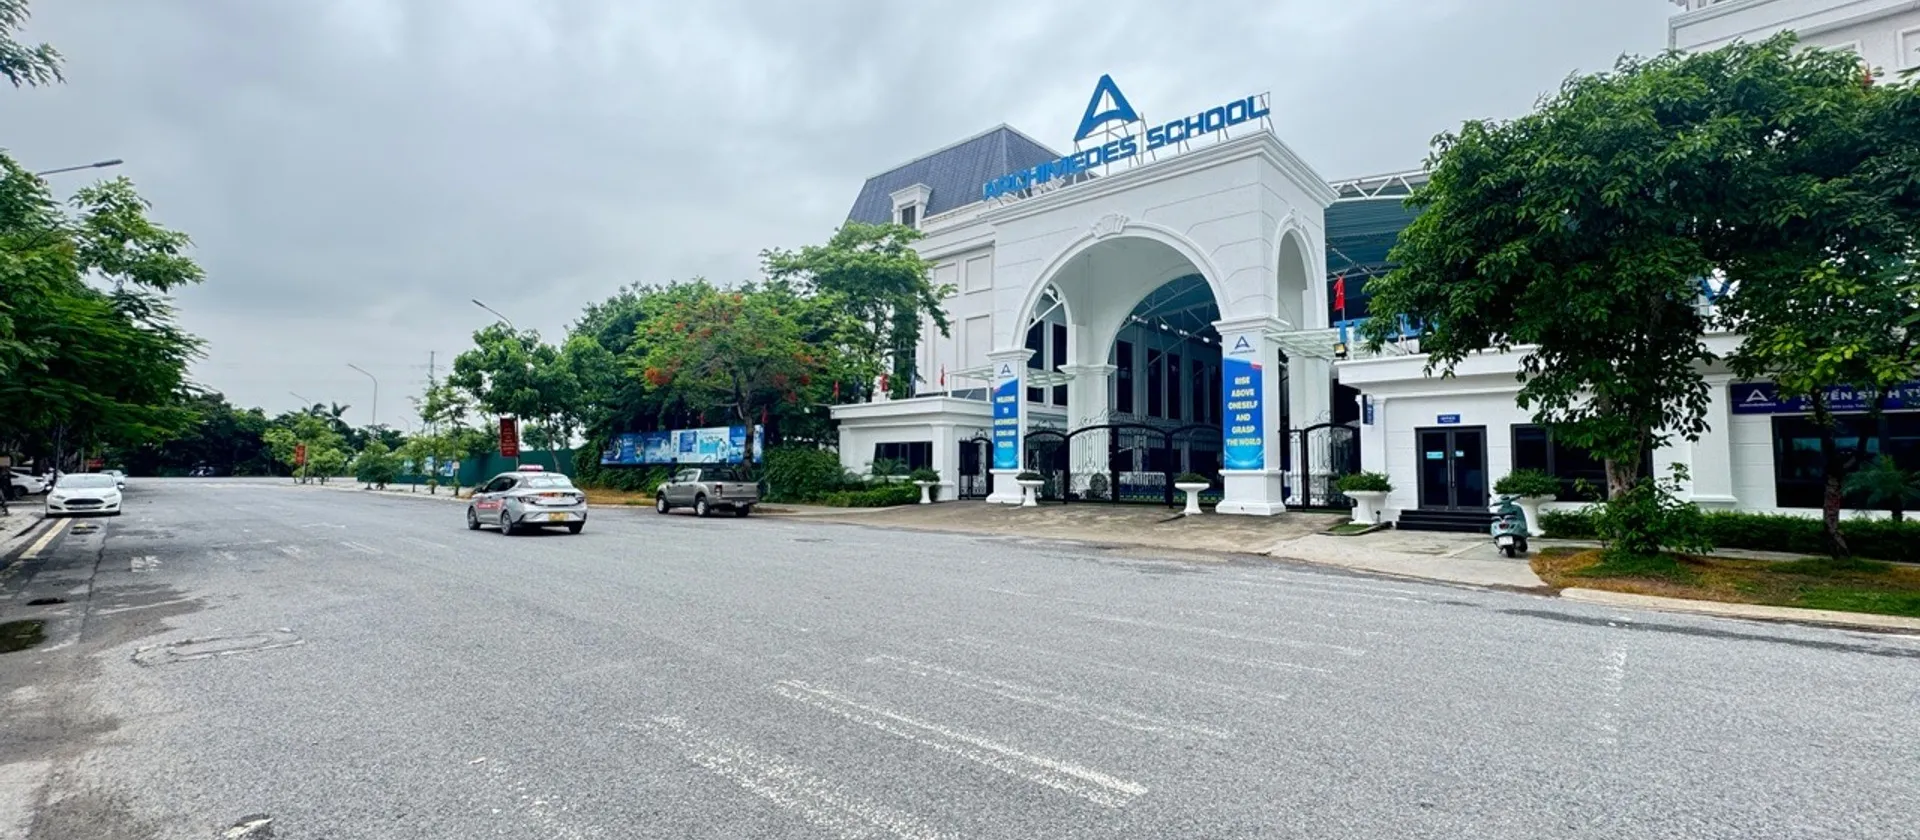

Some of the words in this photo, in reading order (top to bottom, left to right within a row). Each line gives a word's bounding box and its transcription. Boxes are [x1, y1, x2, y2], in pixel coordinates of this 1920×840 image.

[983, 135, 1137, 200] ARCHIMEDES
[1147, 95, 1270, 148] SCHOOL
[1234, 376, 1250, 385] RISE
[1231, 388, 1255, 398] ABOVE
[1228, 401, 1258, 410] ONESELF
[1235, 413, 1251, 422] AND
[1231, 425, 1256, 434] GRASP
[1226, 438, 1238, 447] THE
[1239, 438, 1262, 447] WORLD
